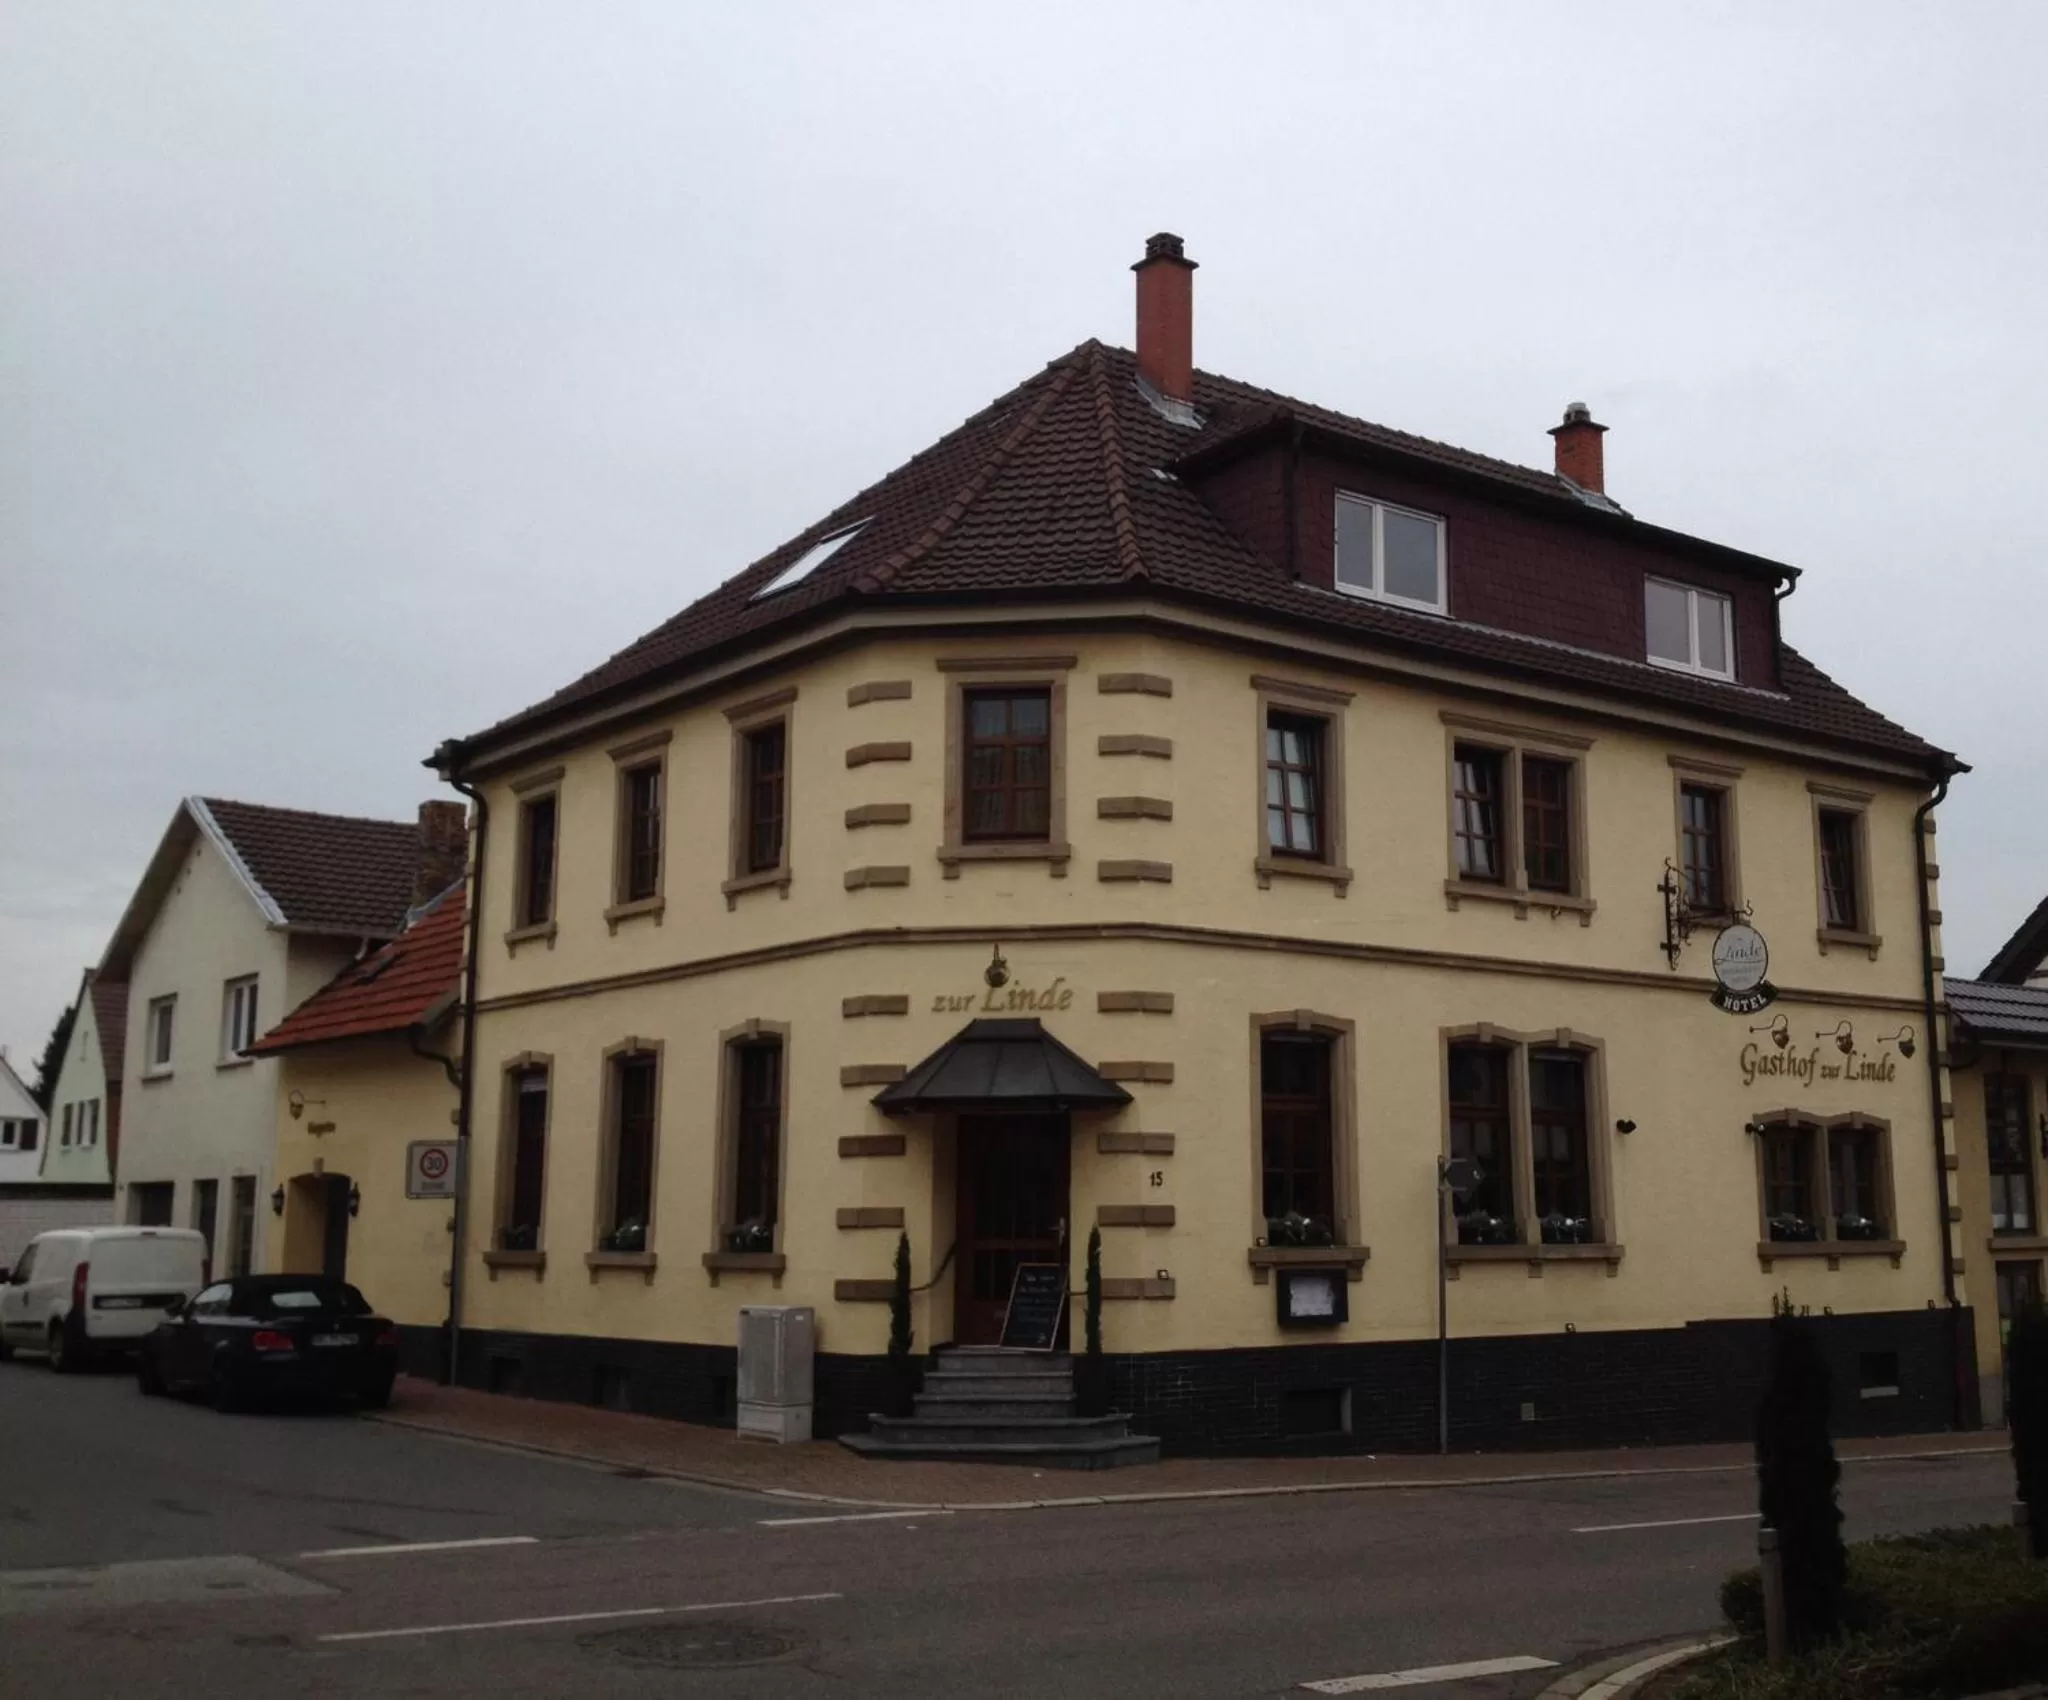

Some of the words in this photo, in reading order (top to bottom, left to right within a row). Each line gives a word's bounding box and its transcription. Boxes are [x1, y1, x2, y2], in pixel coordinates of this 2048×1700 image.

[931, 994, 976, 1013] zur
[980, 977, 1073, 1013] Linde
[1723, 993, 1767, 1012] HOTEL
[1740, 1042, 1819, 1088] Gasthof
[1820, 1063, 1842, 1080] zur
[1844, 1050, 1896, 1082] Linde
[1150, 1171, 1163, 1187] 15
